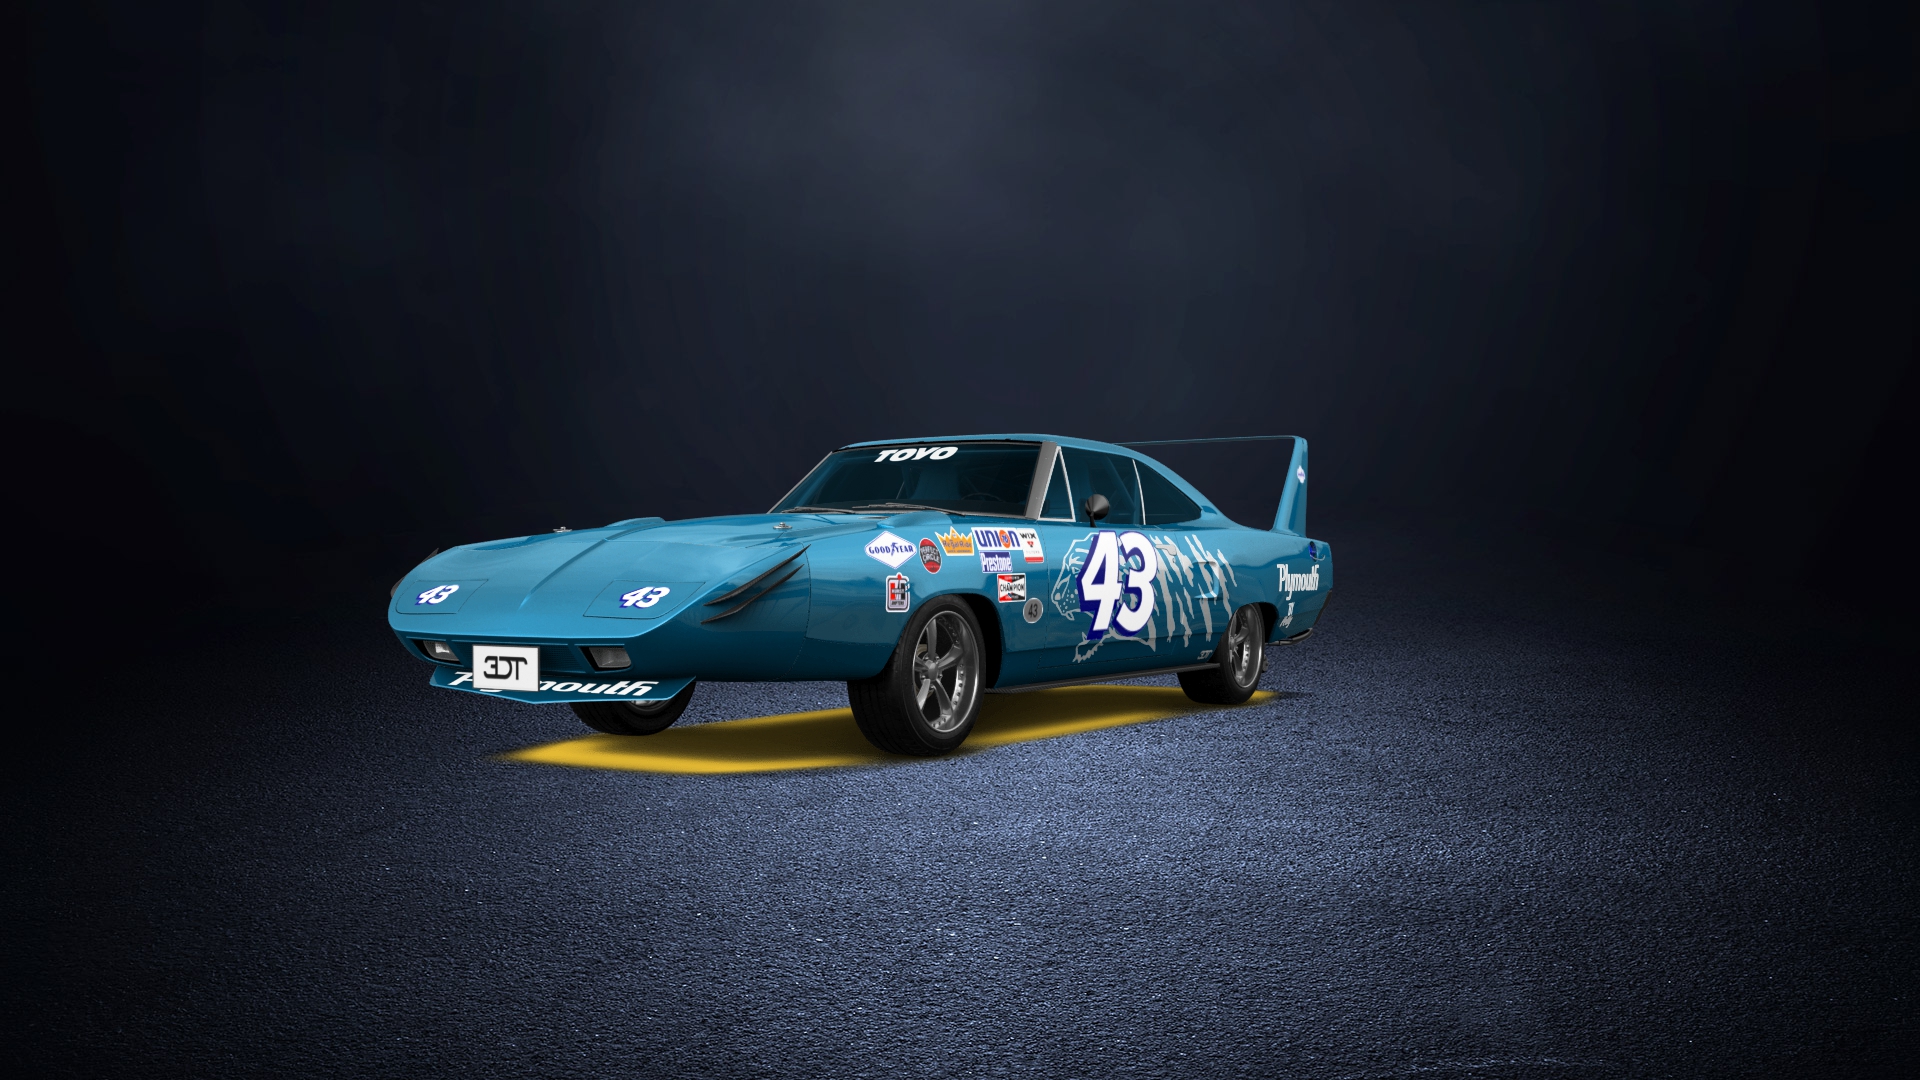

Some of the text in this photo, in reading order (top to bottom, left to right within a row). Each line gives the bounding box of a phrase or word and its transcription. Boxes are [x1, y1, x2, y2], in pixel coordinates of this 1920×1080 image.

[874, 446, 959, 463] TOYO
[1019, 532, 1037, 540] WIX
[980, 552, 1012, 572] Prestone
[1000, 583, 1024, 592] CHAMPION
[1076, 530, 1159, 640] 43
[1276, 563, 1320, 601] Plymouth
[414, 584, 460, 606] 43
[619, 586, 671, 609] 43
[1028, 603, 1038, 618] 43
[483, 655, 528, 681] 3DT
